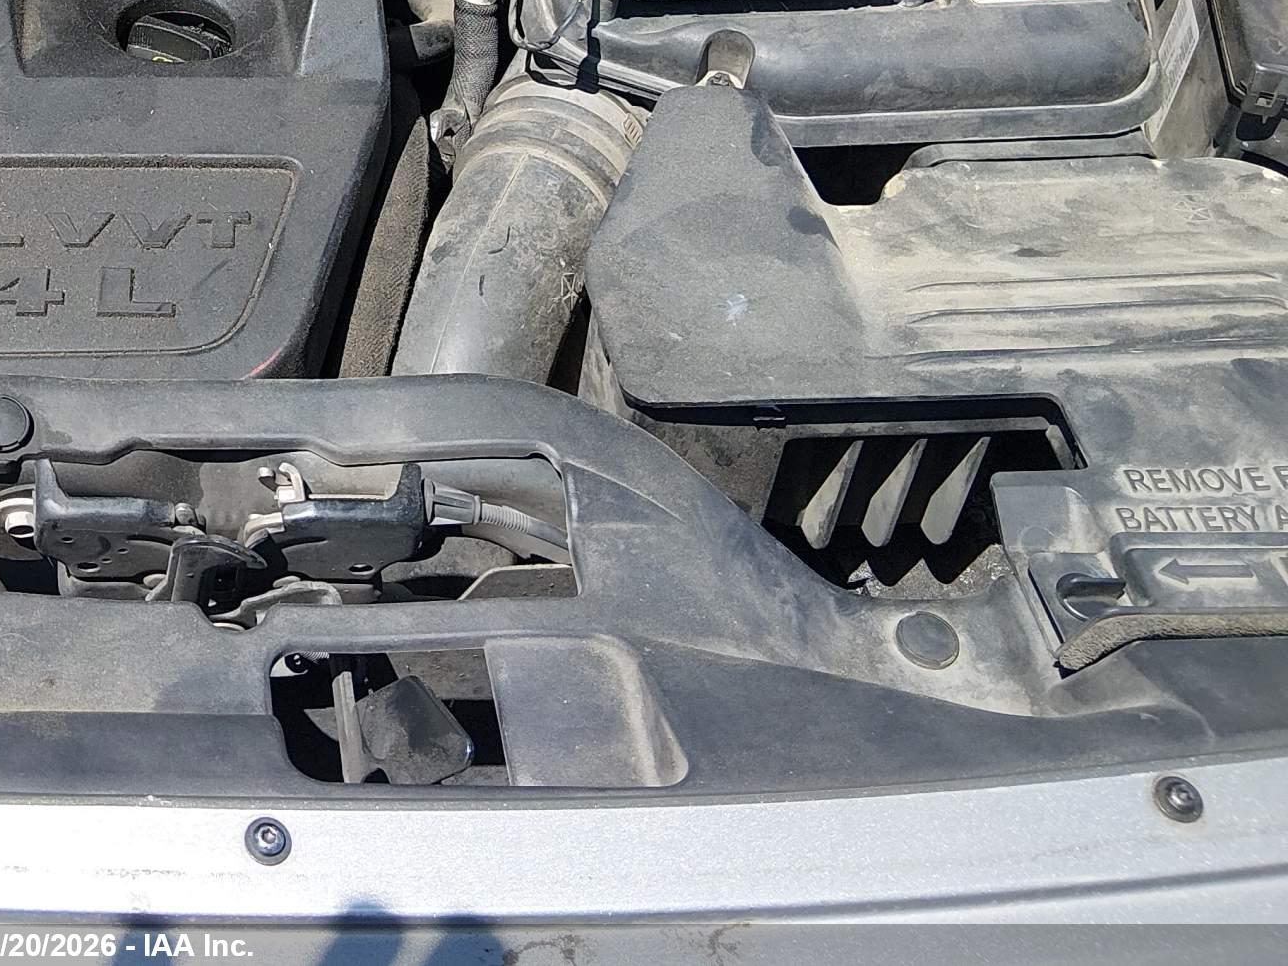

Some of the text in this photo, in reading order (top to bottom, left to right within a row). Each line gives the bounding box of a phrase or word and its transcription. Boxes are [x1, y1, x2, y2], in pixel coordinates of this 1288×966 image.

[45, 211, 252, 249] VVT
[1122, 466, 1271, 494] REMOVE
[1115, 505, 1261, 532] BATTERY
